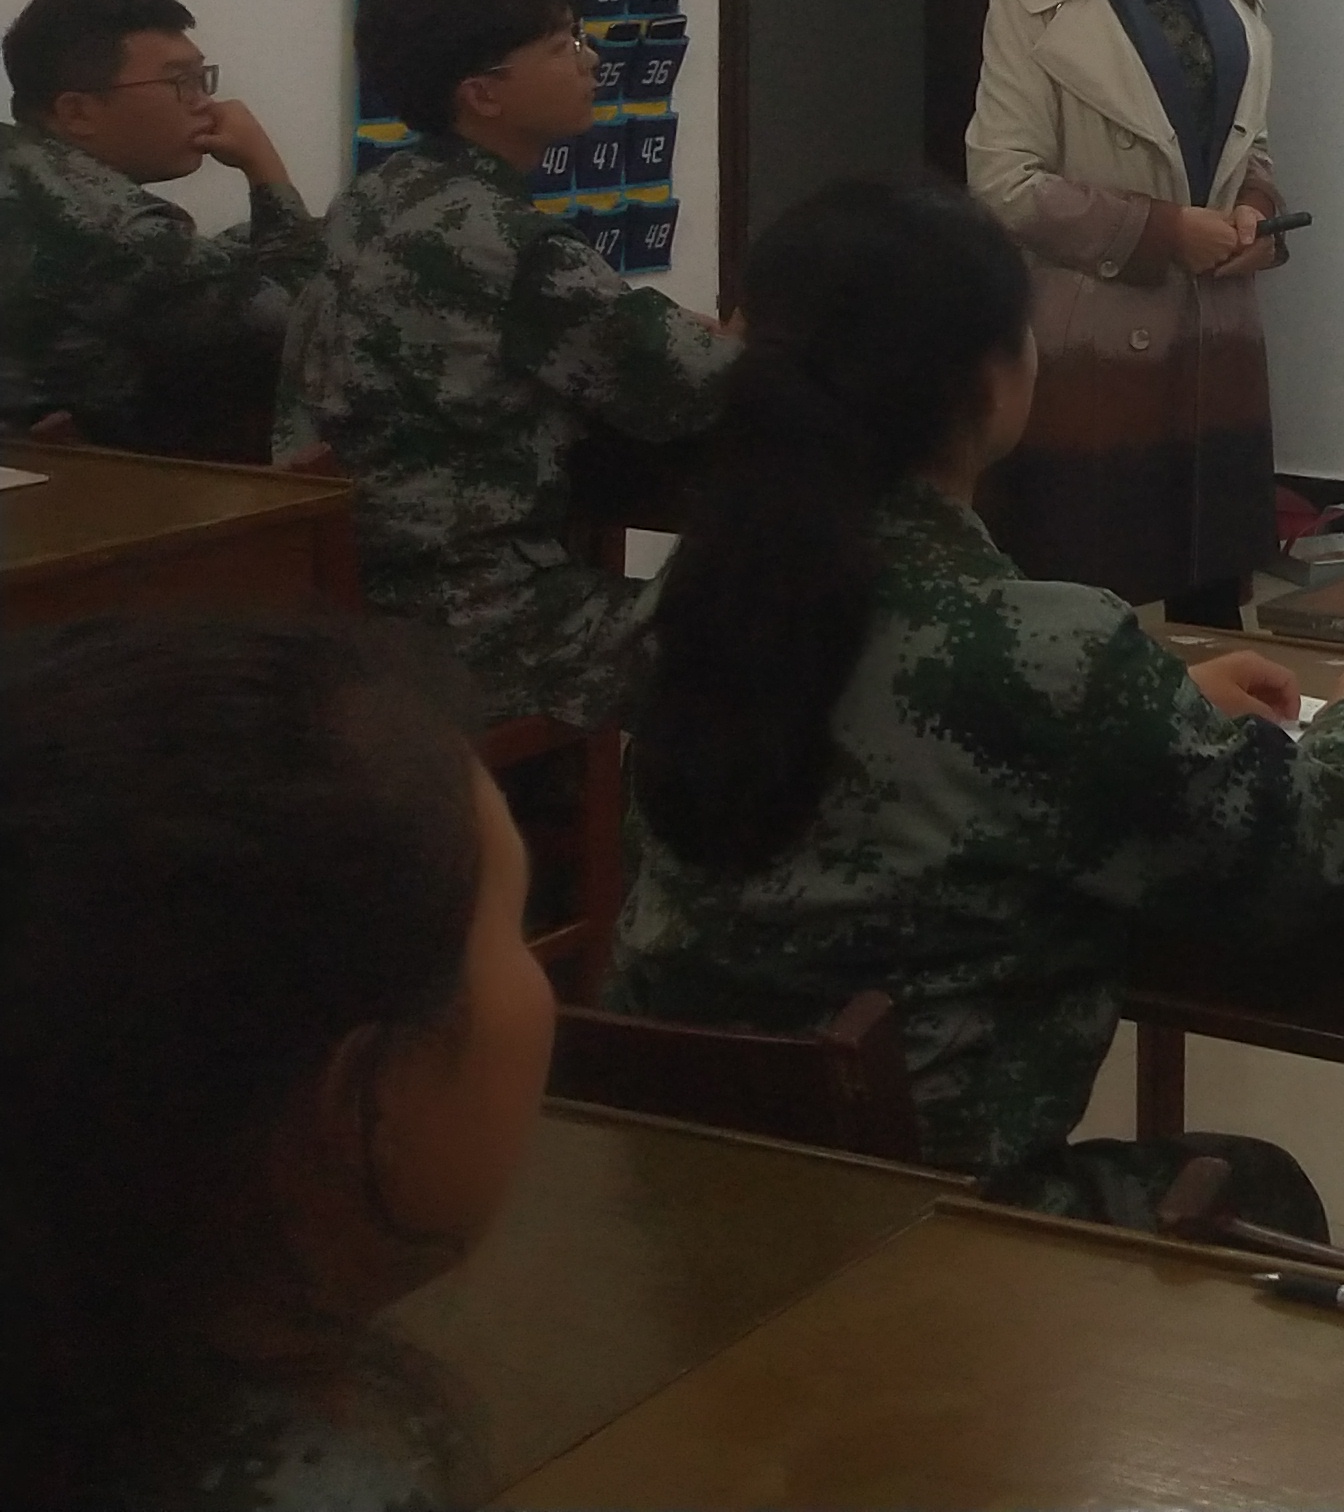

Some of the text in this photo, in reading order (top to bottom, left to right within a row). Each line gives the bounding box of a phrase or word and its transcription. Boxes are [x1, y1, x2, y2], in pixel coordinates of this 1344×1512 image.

[596, 60, 672, 87] 35 36
[542, 137, 665, 175] 40 41 42
[595, 223, 670, 255] 47 48
